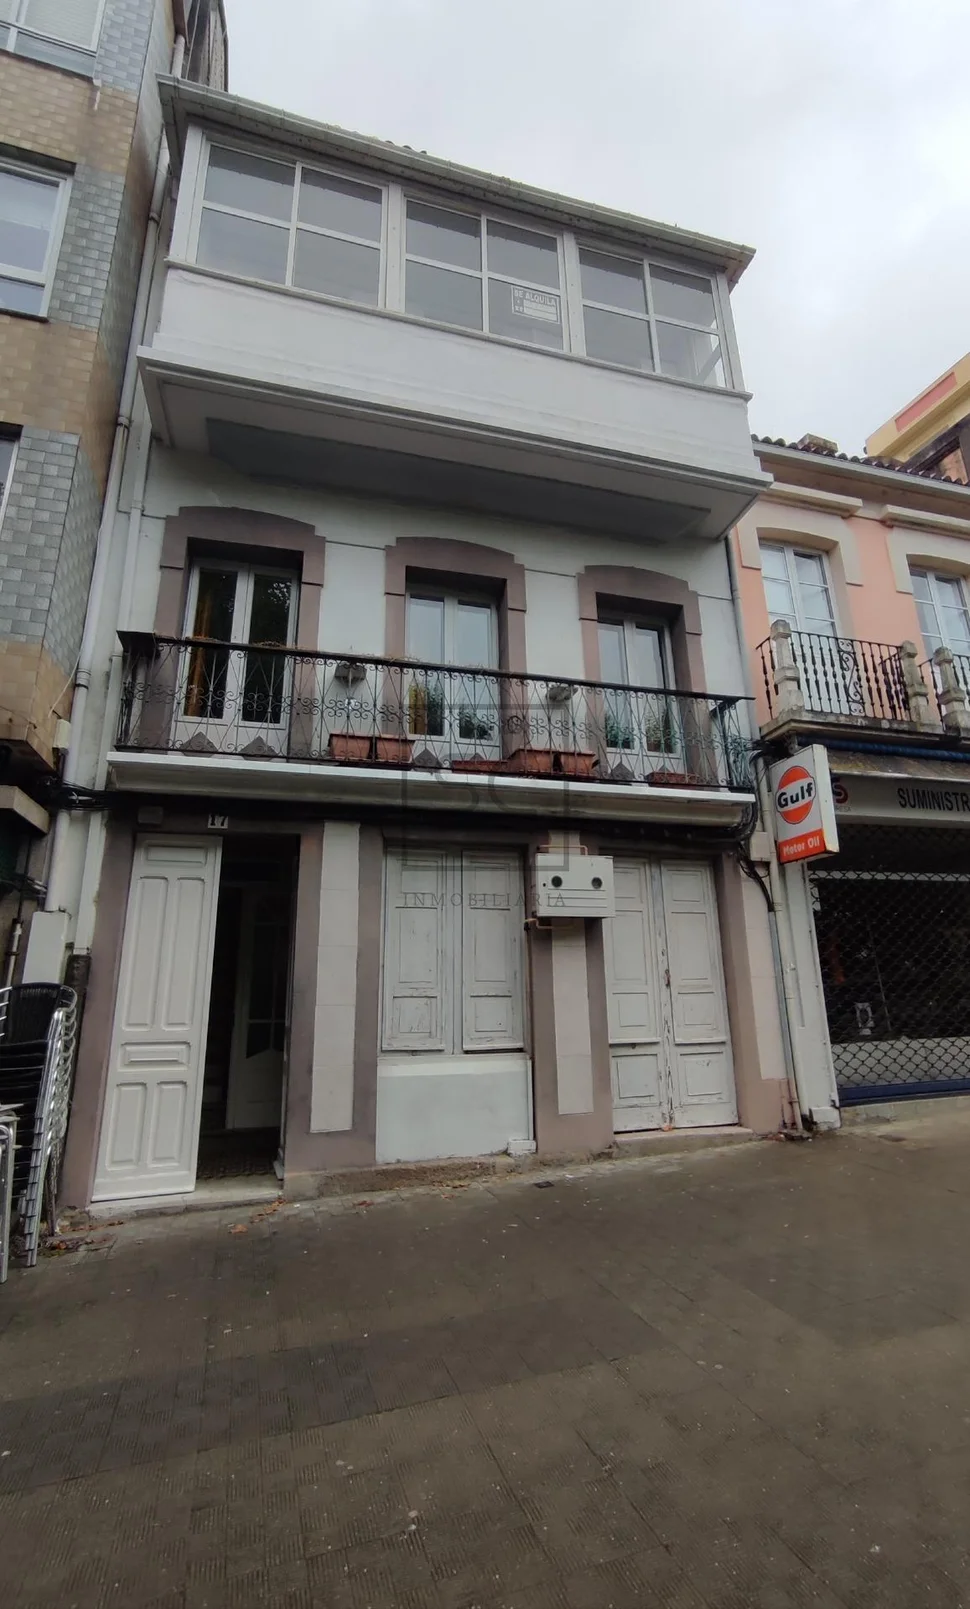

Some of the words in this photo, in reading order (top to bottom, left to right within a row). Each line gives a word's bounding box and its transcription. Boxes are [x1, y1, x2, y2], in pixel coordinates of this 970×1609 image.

[514, 289, 524, 298] SE
[525, 292, 556, 306] ALQUILA
[777, 782, 813, 808] Gulf
[897, 787, 970, 812] SUMINISTR
[210, 814, 226, 827] 17
[783, 842, 806, 856] Motor
[807, 835, 820, 849] Oil
